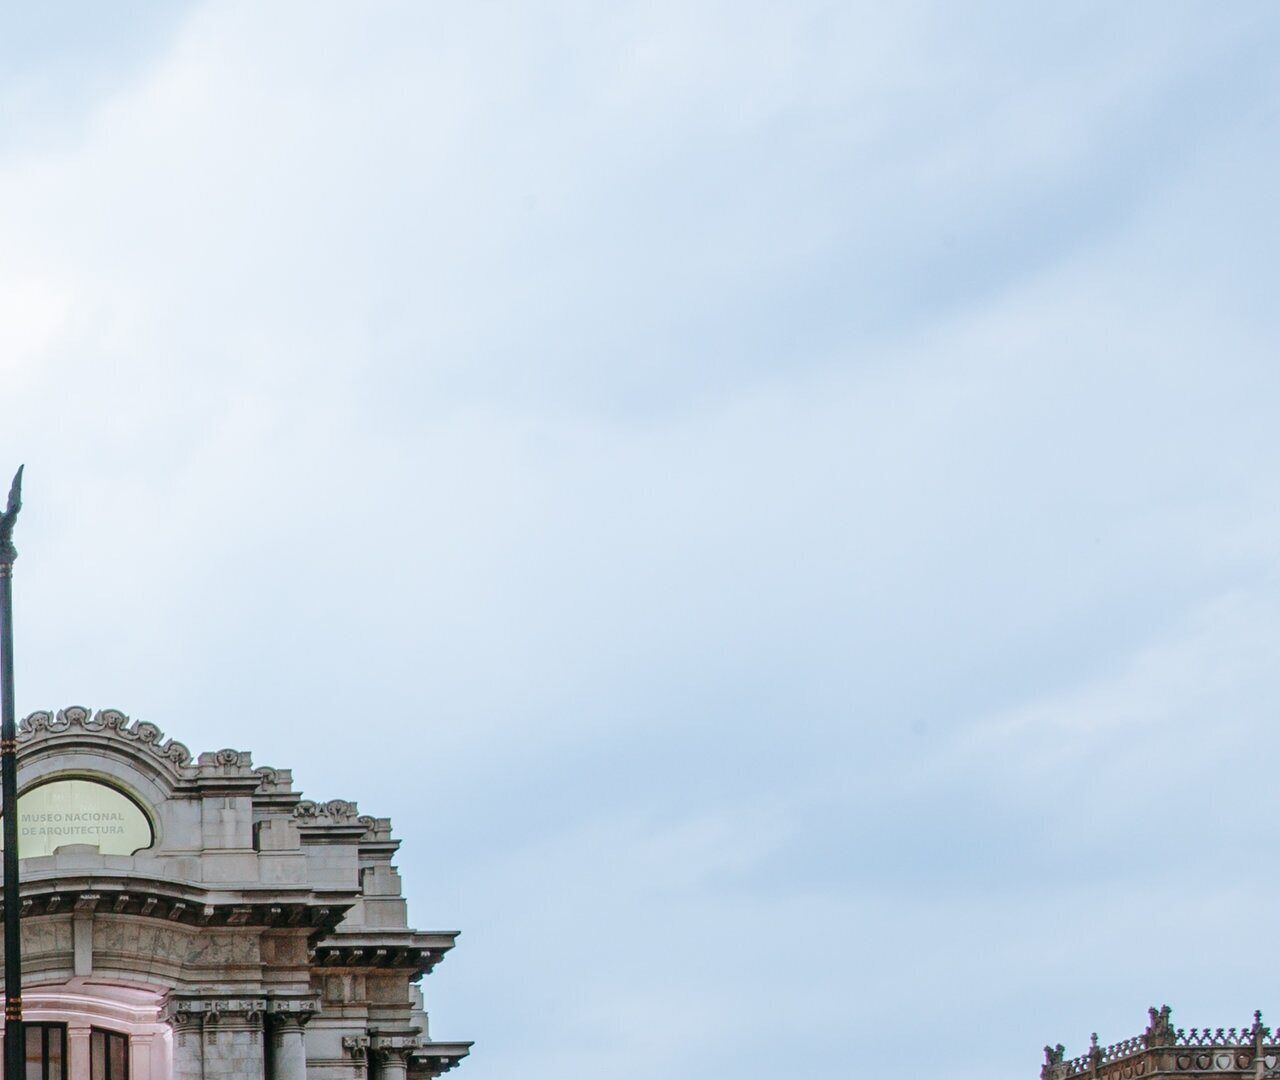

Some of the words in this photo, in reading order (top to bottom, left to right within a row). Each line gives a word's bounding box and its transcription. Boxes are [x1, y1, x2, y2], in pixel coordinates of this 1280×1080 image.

[21, 813, 62, 823] MUSEO
[65, 812, 125, 822] NACIONAL
[21, 826, 38, 836] DE
[40, 825, 125, 836] ARQUITECTURA
